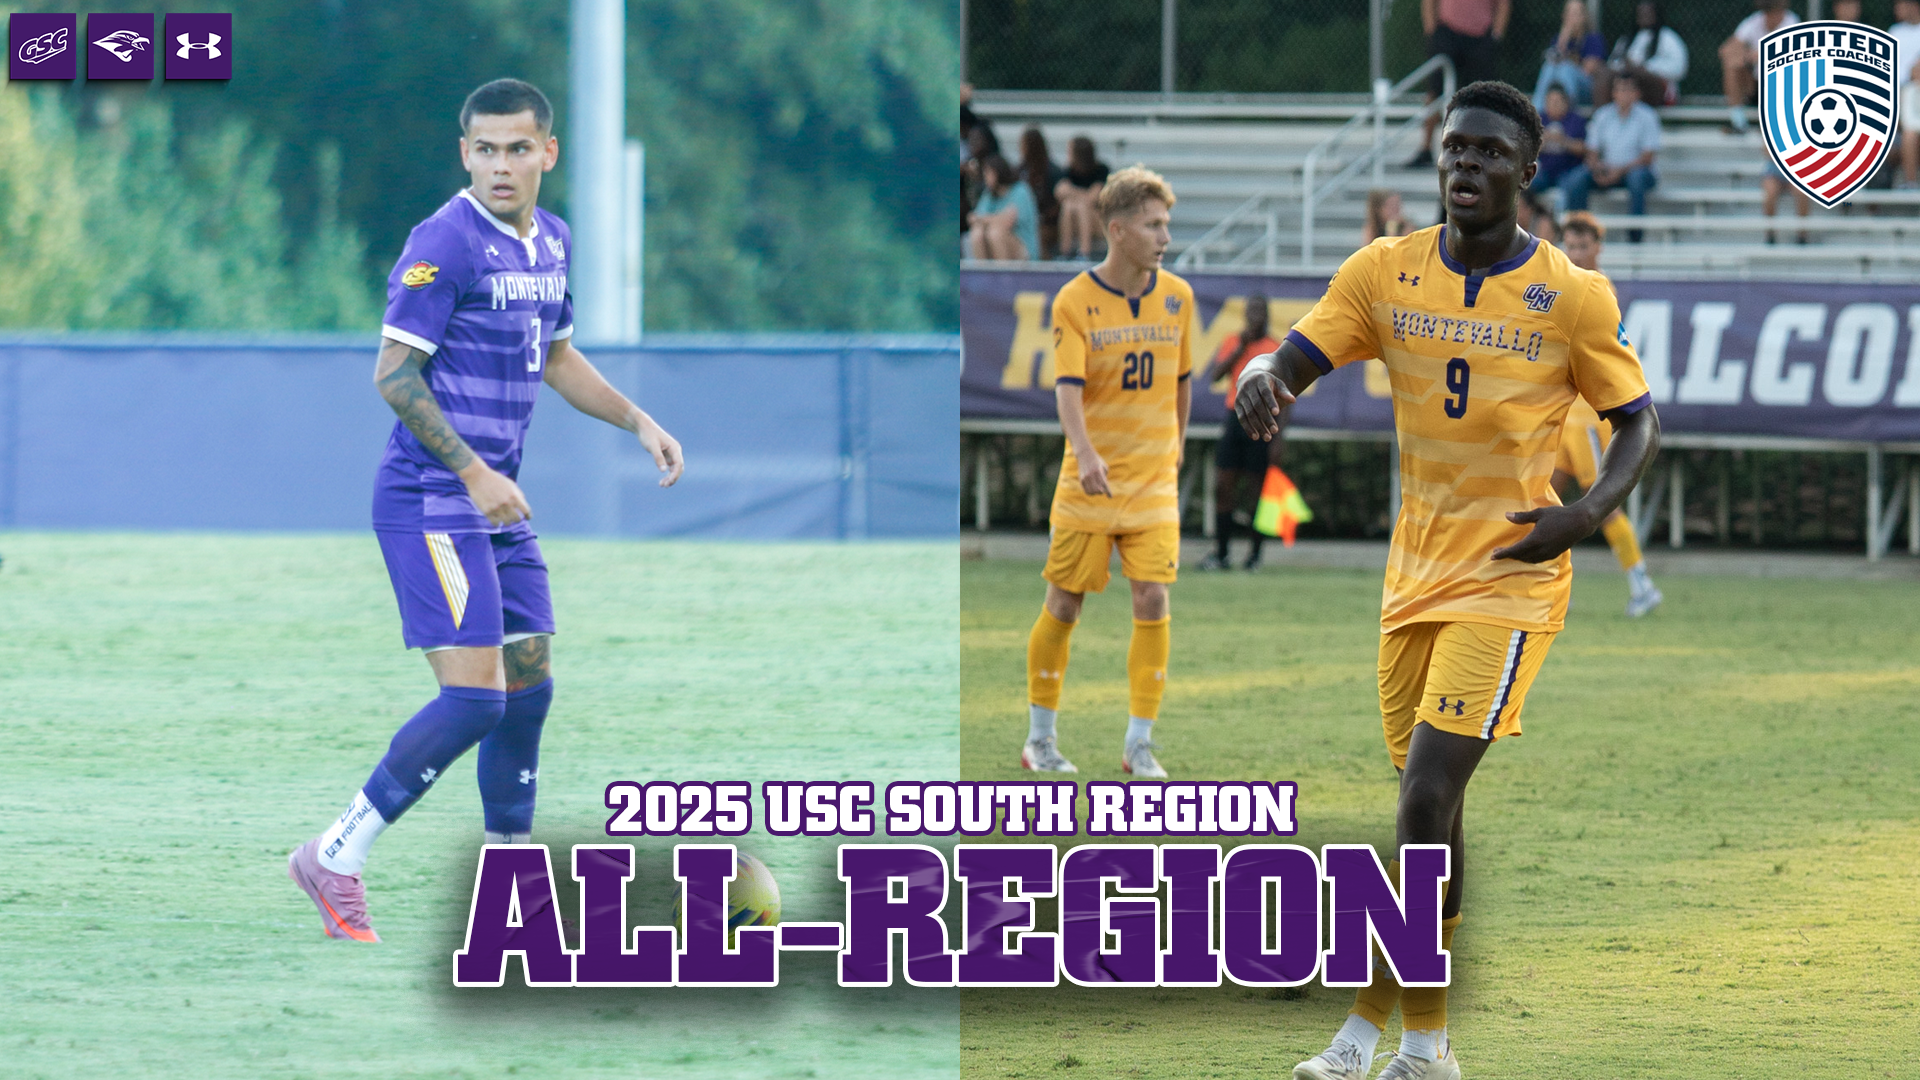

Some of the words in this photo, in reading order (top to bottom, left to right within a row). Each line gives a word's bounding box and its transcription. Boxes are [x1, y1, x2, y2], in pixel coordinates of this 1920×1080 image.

[401, 266, 440, 286] GSC
[491, 275, 567, 310] MONTEVALL
[1522, 282, 1557, 314] UM
[526, 317, 542, 373] 3
[1089, 323, 1180, 352] MONTEVALLO
[1391, 307, 1543, 362] MONTEVALLO
[1621, 298, 1920, 408] ALCO
[1121, 351, 1155, 390] 20
[1443, 356, 1471, 420] 9
